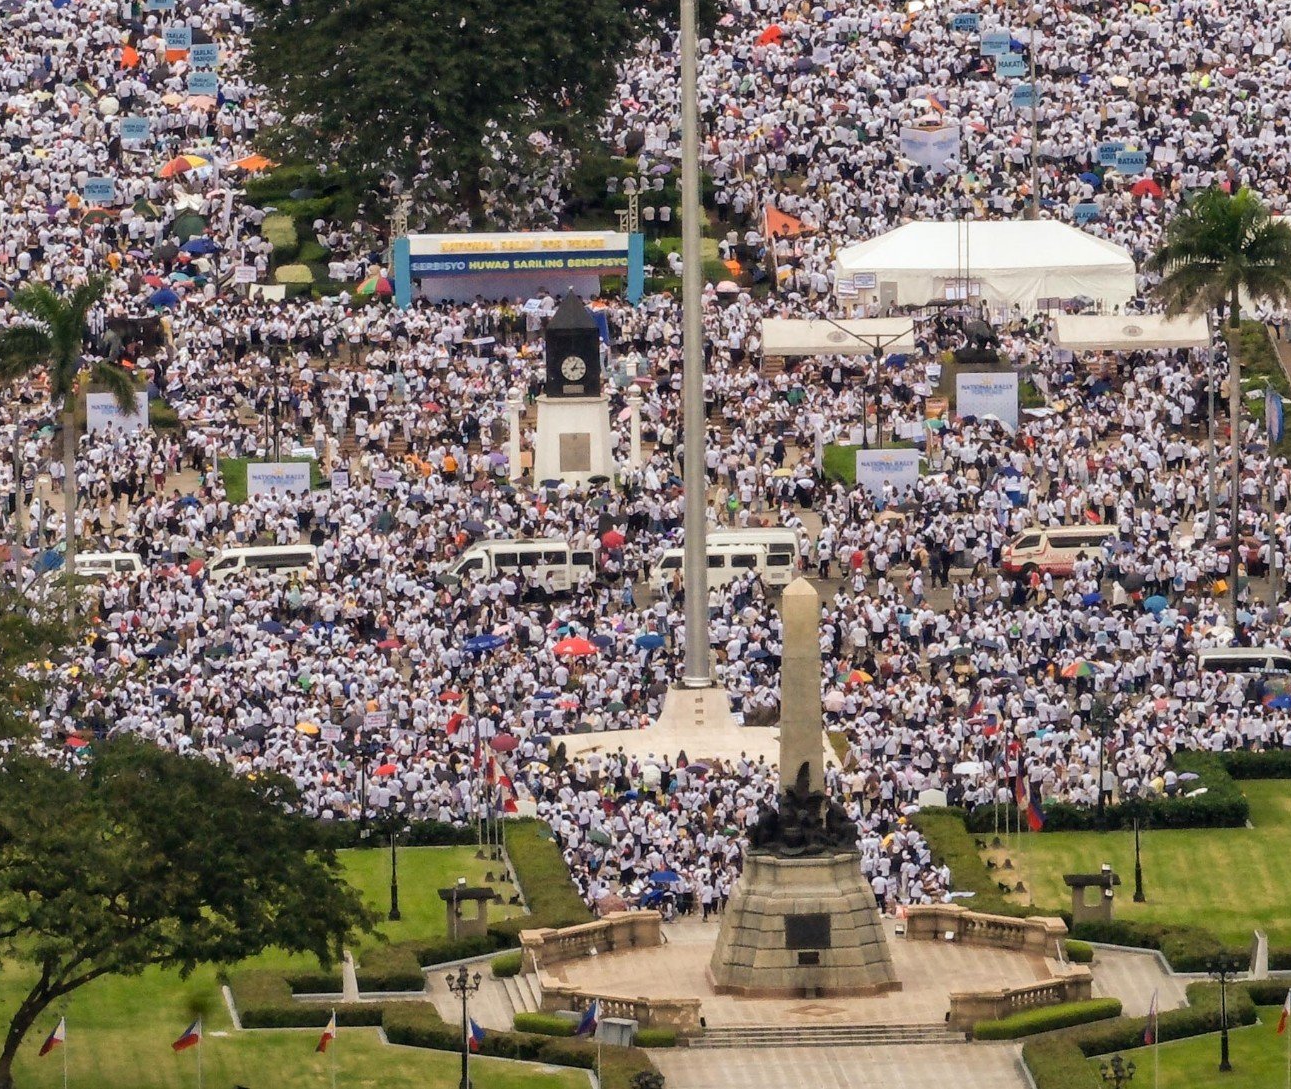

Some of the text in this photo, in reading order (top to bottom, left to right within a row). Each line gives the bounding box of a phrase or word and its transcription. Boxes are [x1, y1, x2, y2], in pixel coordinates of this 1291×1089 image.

[998, 60, 1023, 68] MAKATI
[441, 241, 495, 253] NATIONAL
[500, 240, 535, 252] RALLY
[566, 239, 605, 250] PEACE
[411, 257, 628, 271] SERBISYO HUWAG SARILING BENEPISYO
